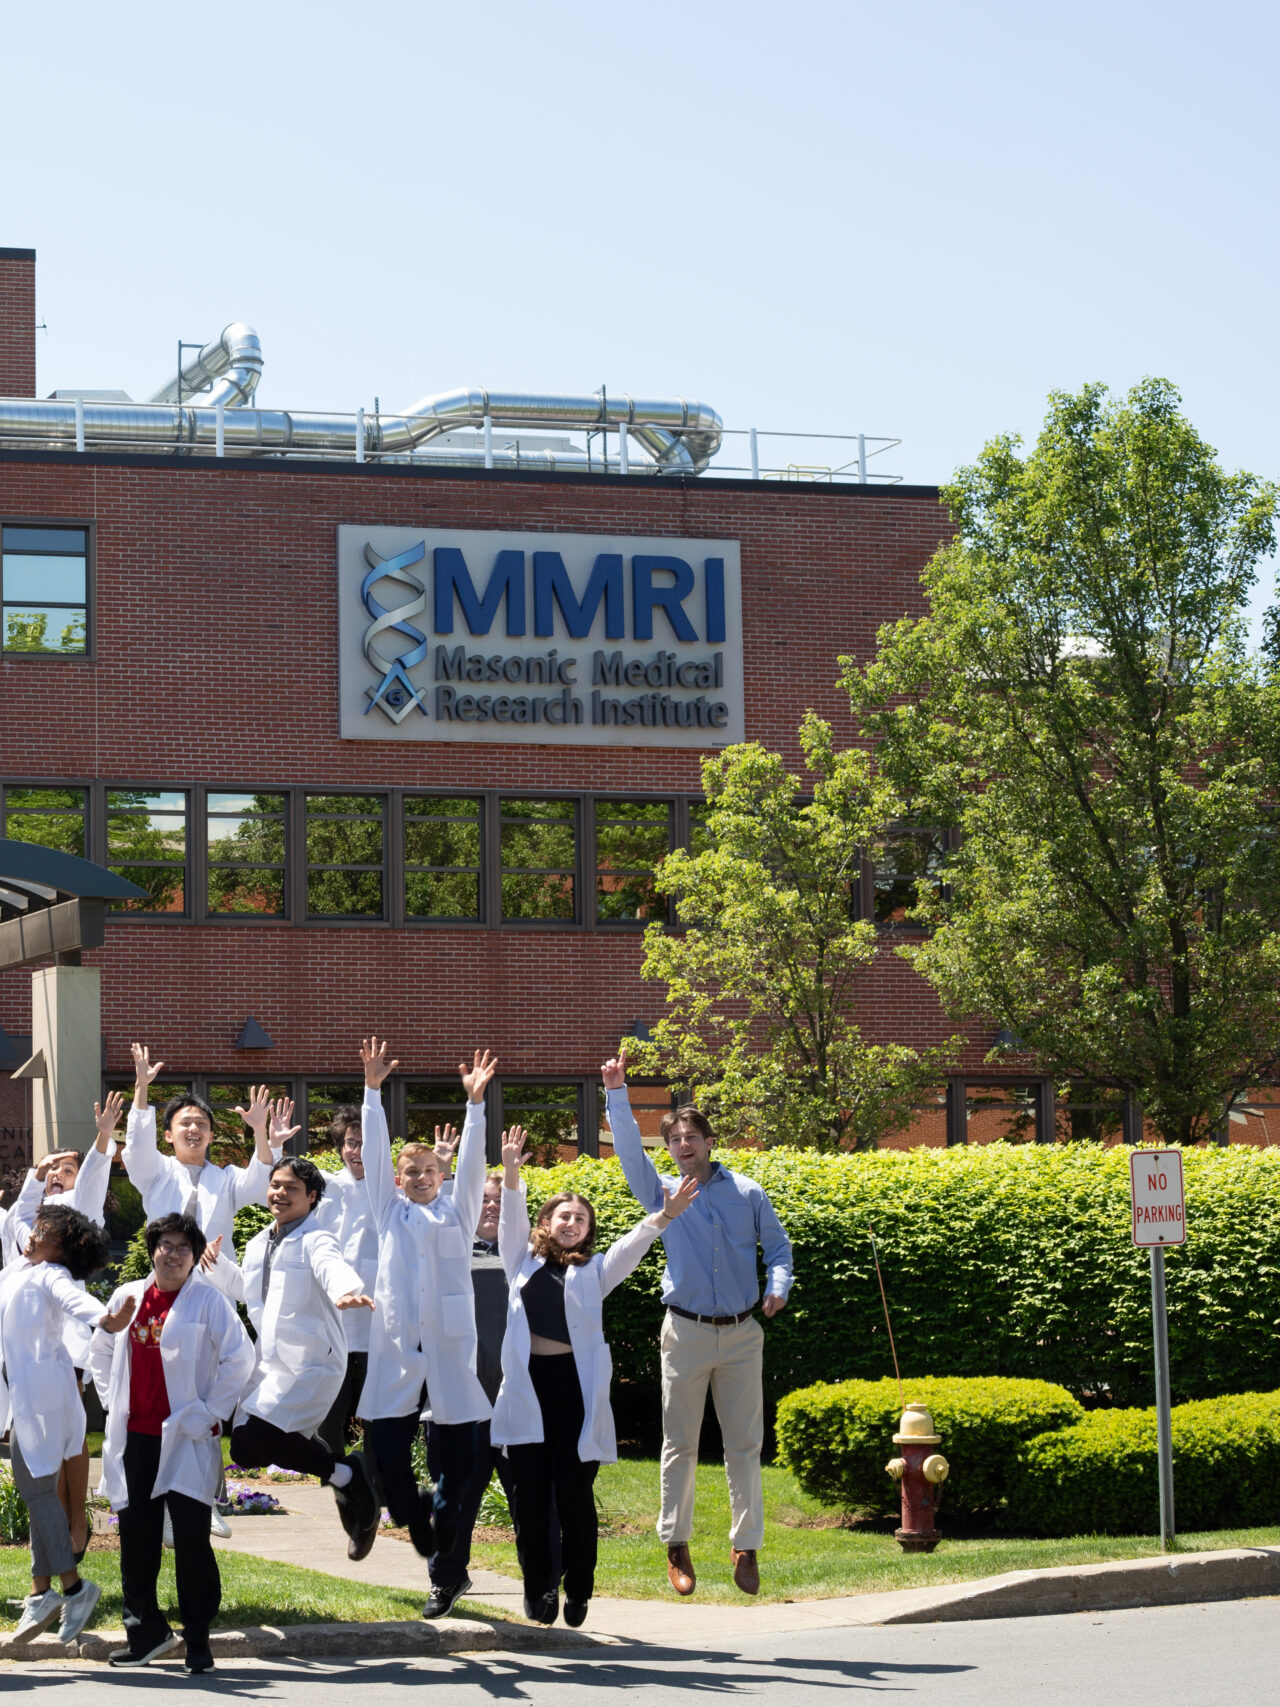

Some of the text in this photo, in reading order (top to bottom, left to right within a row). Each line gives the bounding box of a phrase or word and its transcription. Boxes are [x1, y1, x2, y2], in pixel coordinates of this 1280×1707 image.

[434, 547, 726, 643] MMRI
[434, 644, 723, 688] Masonic Medical
[385, 688, 404, 706] G
[435, 685, 729, 728] Research Institute
[1148, 1173, 1167, 1191] NO
[1136, 1205, 1182, 1224] PARKING
